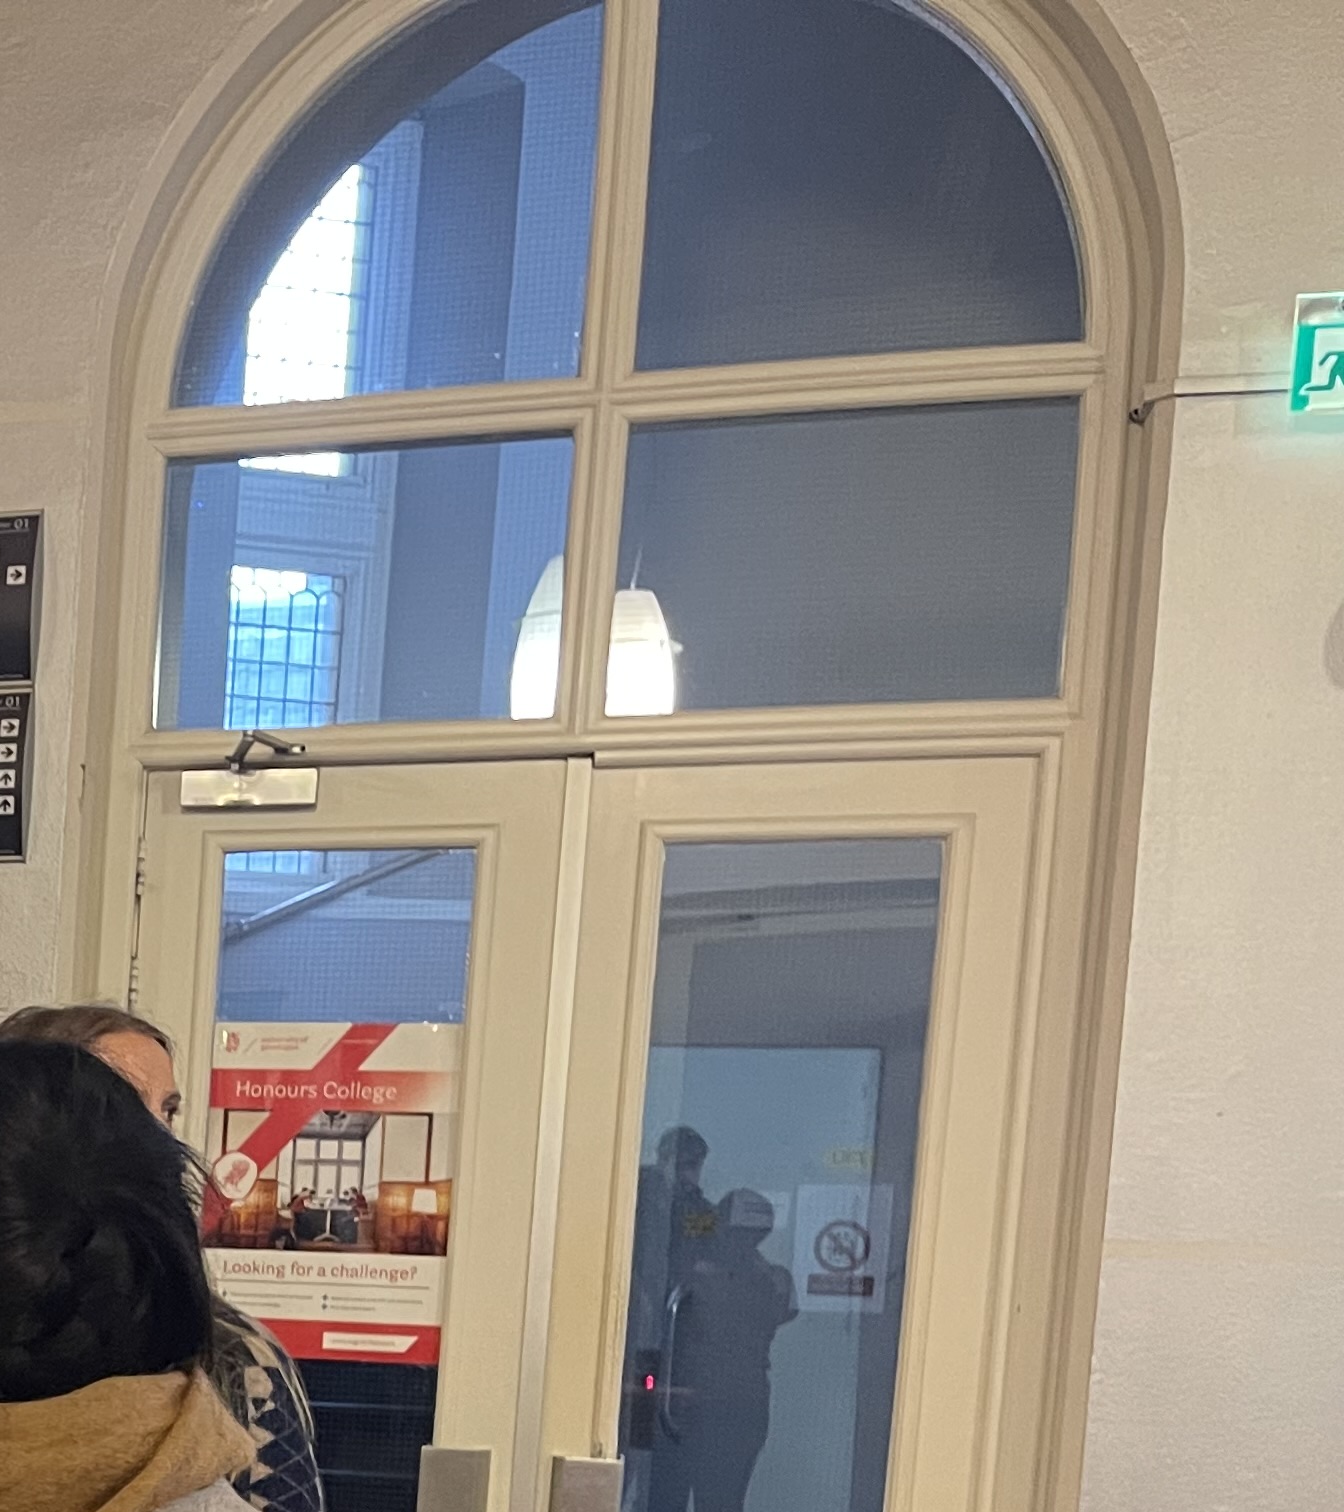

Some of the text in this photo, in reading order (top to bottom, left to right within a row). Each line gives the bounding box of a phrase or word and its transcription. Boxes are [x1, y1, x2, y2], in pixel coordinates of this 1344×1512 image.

[236, 1080, 397, 1103] Honours College
[223, 1260, 418, 1282] Looking for a challenge?
